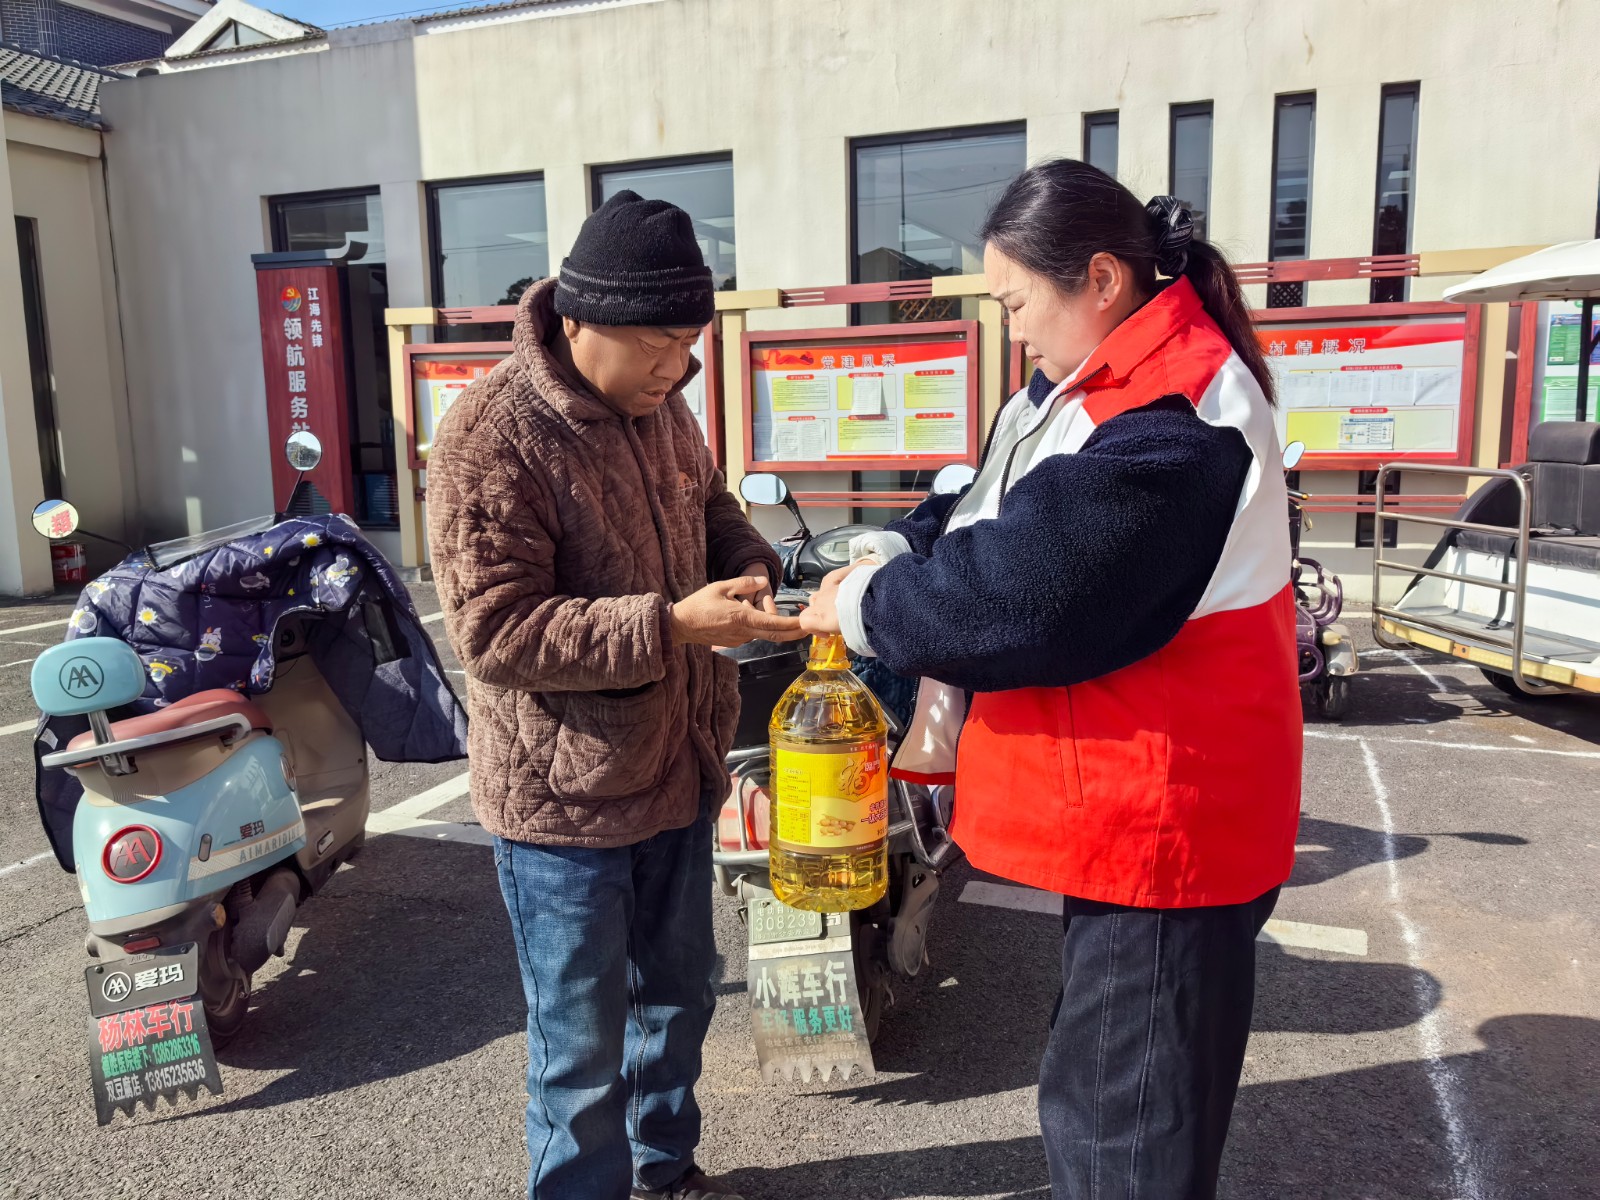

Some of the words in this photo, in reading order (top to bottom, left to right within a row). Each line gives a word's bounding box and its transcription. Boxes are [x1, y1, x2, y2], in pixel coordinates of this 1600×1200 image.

[307, 287, 323, 348] 江海先锋
[1269, 337, 1366, 356] 村情概况
[821, 354, 896, 370] 党建风采
[240, 820, 265, 840] 爱玛
[756, 912, 816, 932] 308239
[134, 963, 184, 991] 爱玛
[756, 960, 848, 1008] 小辉车行
[98, 999, 194, 1053] 杨林车行
[792, 1004, 853, 1035] 服务更好
